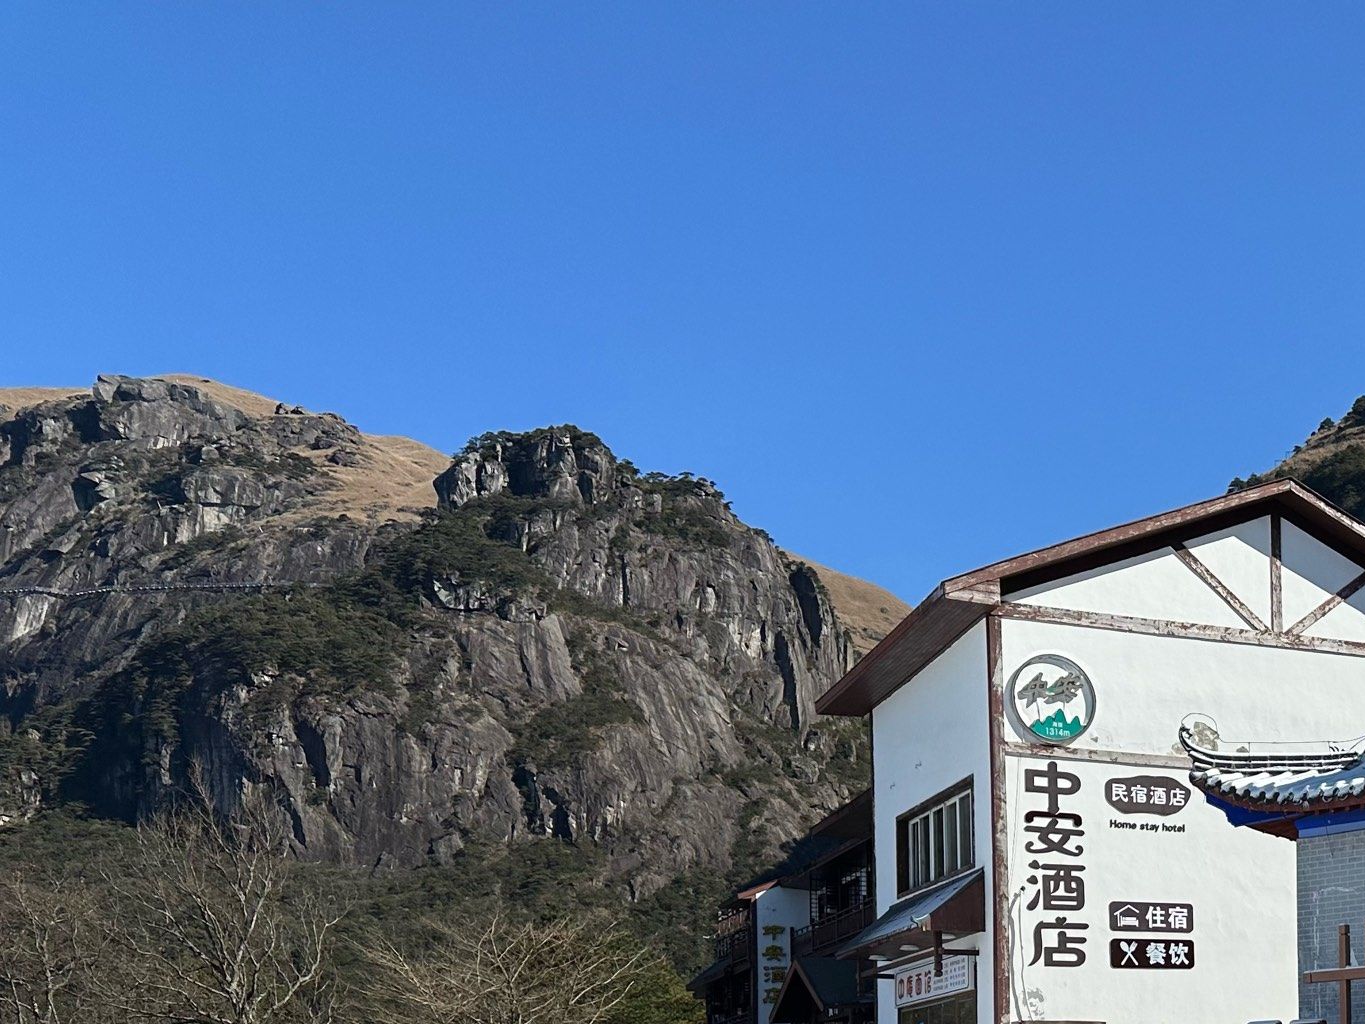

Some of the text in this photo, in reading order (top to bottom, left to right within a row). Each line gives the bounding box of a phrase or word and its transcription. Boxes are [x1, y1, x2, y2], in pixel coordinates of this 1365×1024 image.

[1045, 727, 1070, 737] 1314m
[1111, 783, 1186, 806] 民宿酒店
[1109, 819, 1186, 833] Home stay hotel
[1023, 761, 1089, 968] 中安酒店
[1145, 906, 1188, 929] 住宿
[1145, 942, 1190, 965] 餐饮
